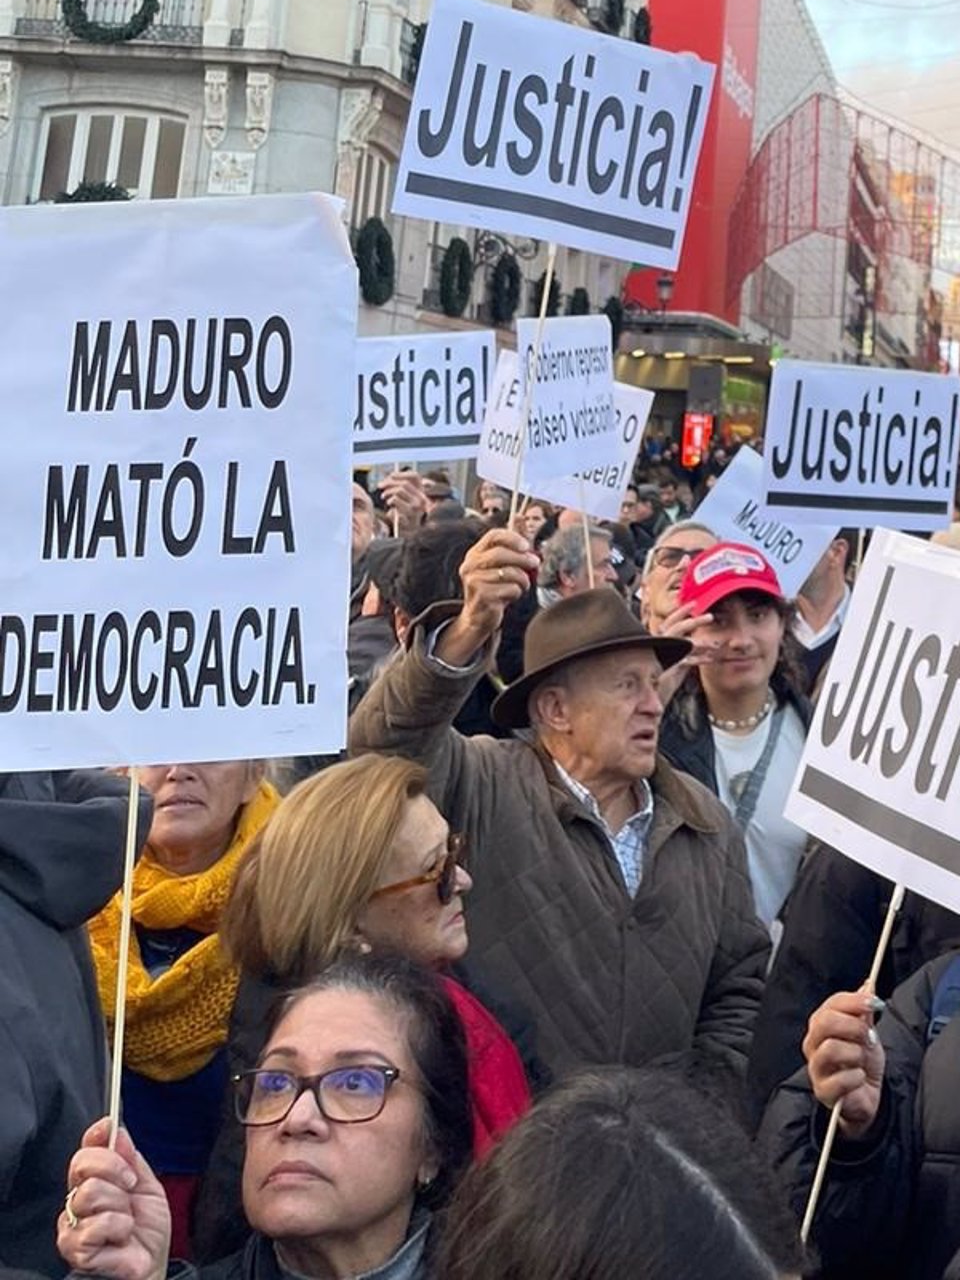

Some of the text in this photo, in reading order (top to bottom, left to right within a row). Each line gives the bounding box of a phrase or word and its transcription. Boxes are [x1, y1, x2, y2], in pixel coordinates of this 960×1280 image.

[417, 21, 703, 213] Justicia!
[66, 315, 293, 413] MADURO
[772, 379, 959, 489] Justicia!
[42, 437, 296, 560] MATÓ LA
[733, 499, 804, 565] MADURO
[0, 607, 316, 714] DEMOCRACIA.
